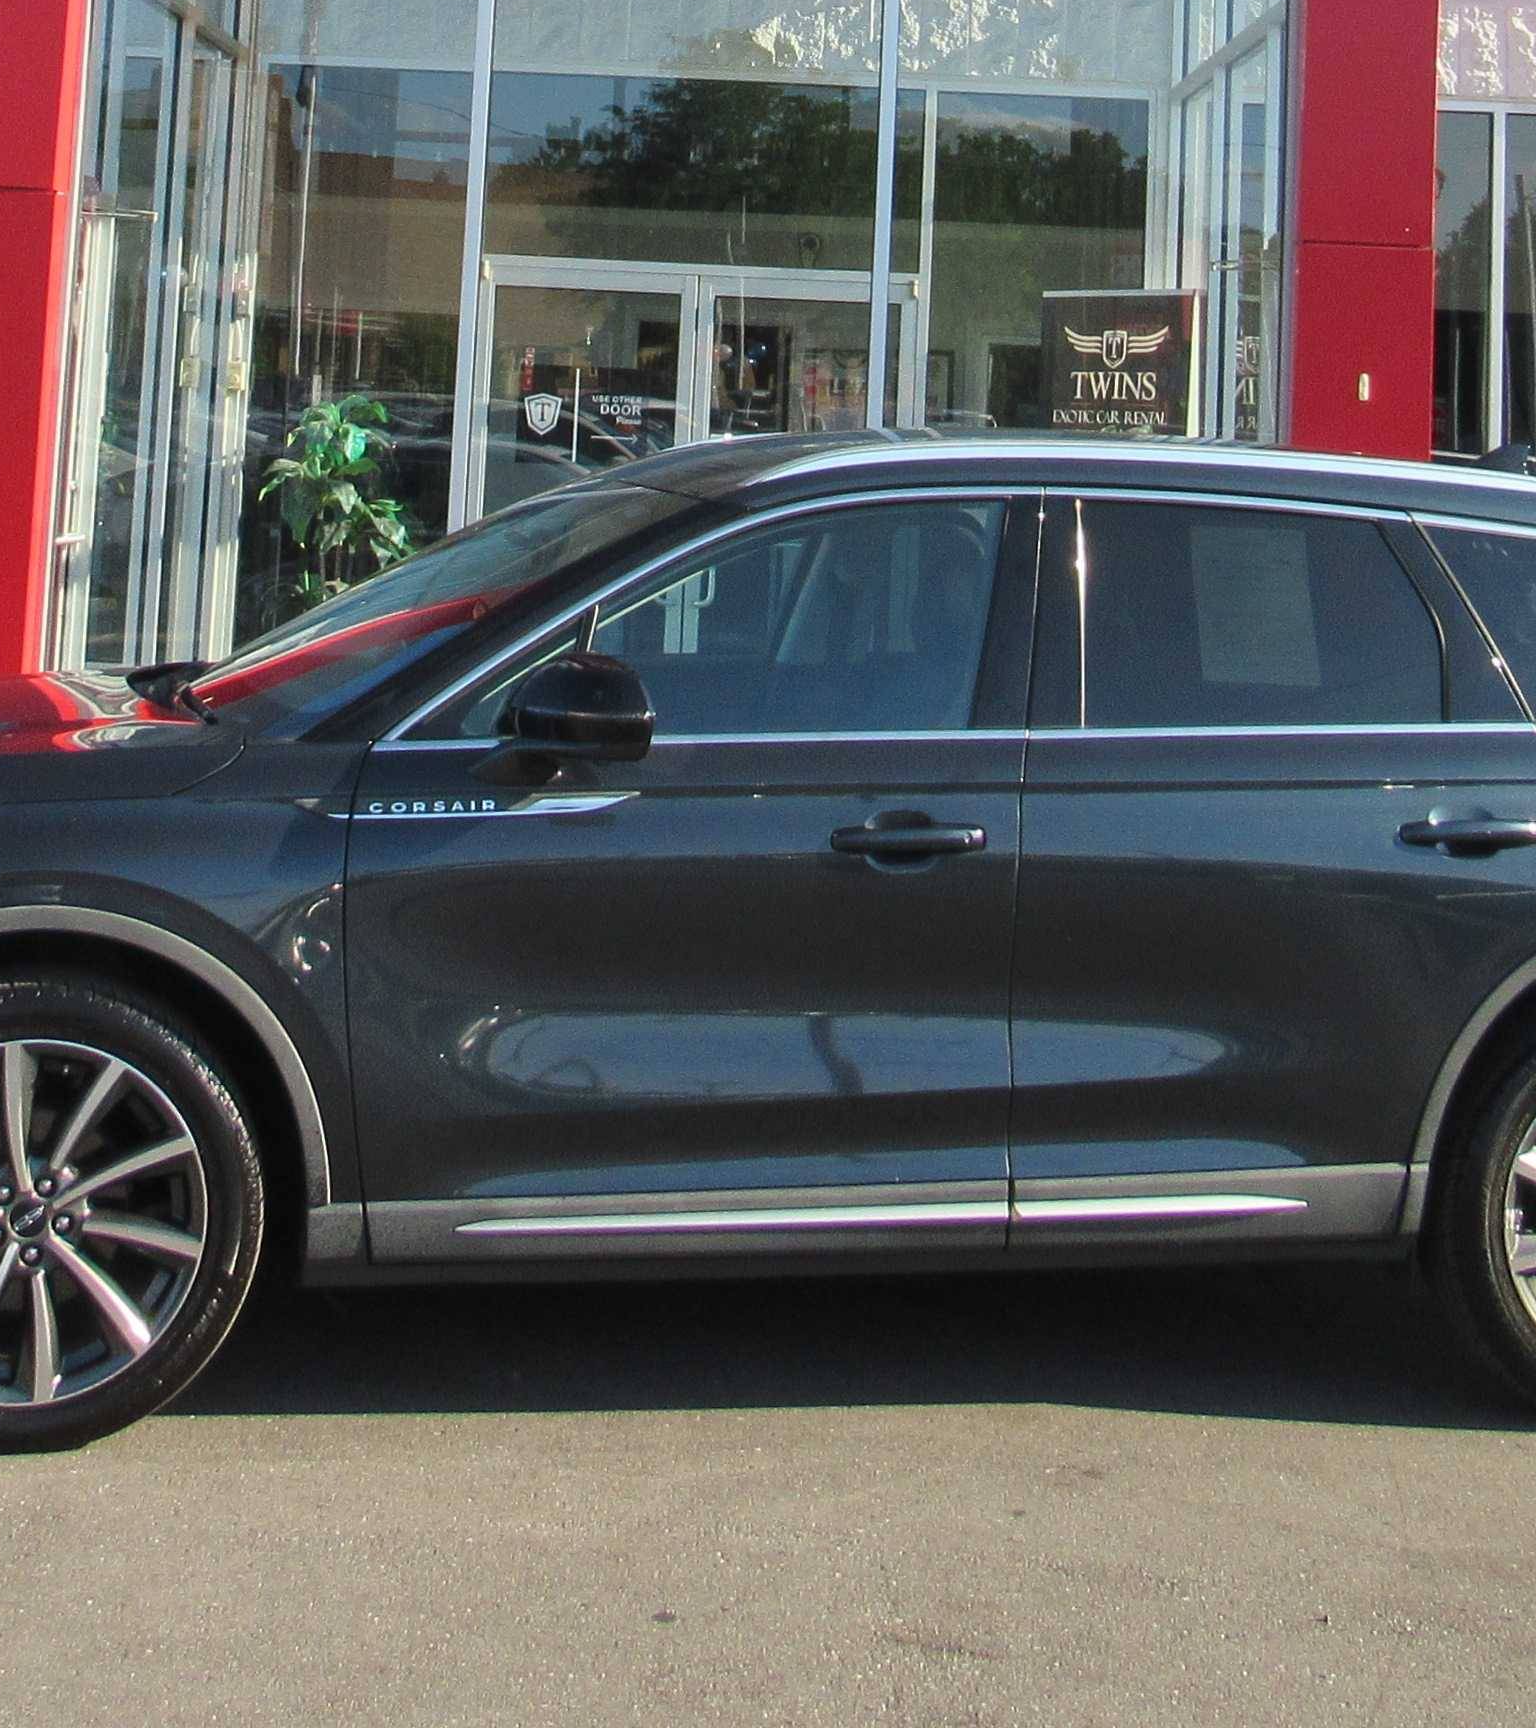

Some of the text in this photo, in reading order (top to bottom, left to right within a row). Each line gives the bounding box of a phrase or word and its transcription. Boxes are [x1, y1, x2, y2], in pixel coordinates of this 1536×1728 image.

[1070, 371, 1157, 401] TWINS
[600, 403, 642, 416] DOOR
[1052, 409, 1168, 426] EXOTIC CAR RENTAL
[369, 799, 496, 813] CORSAIR
